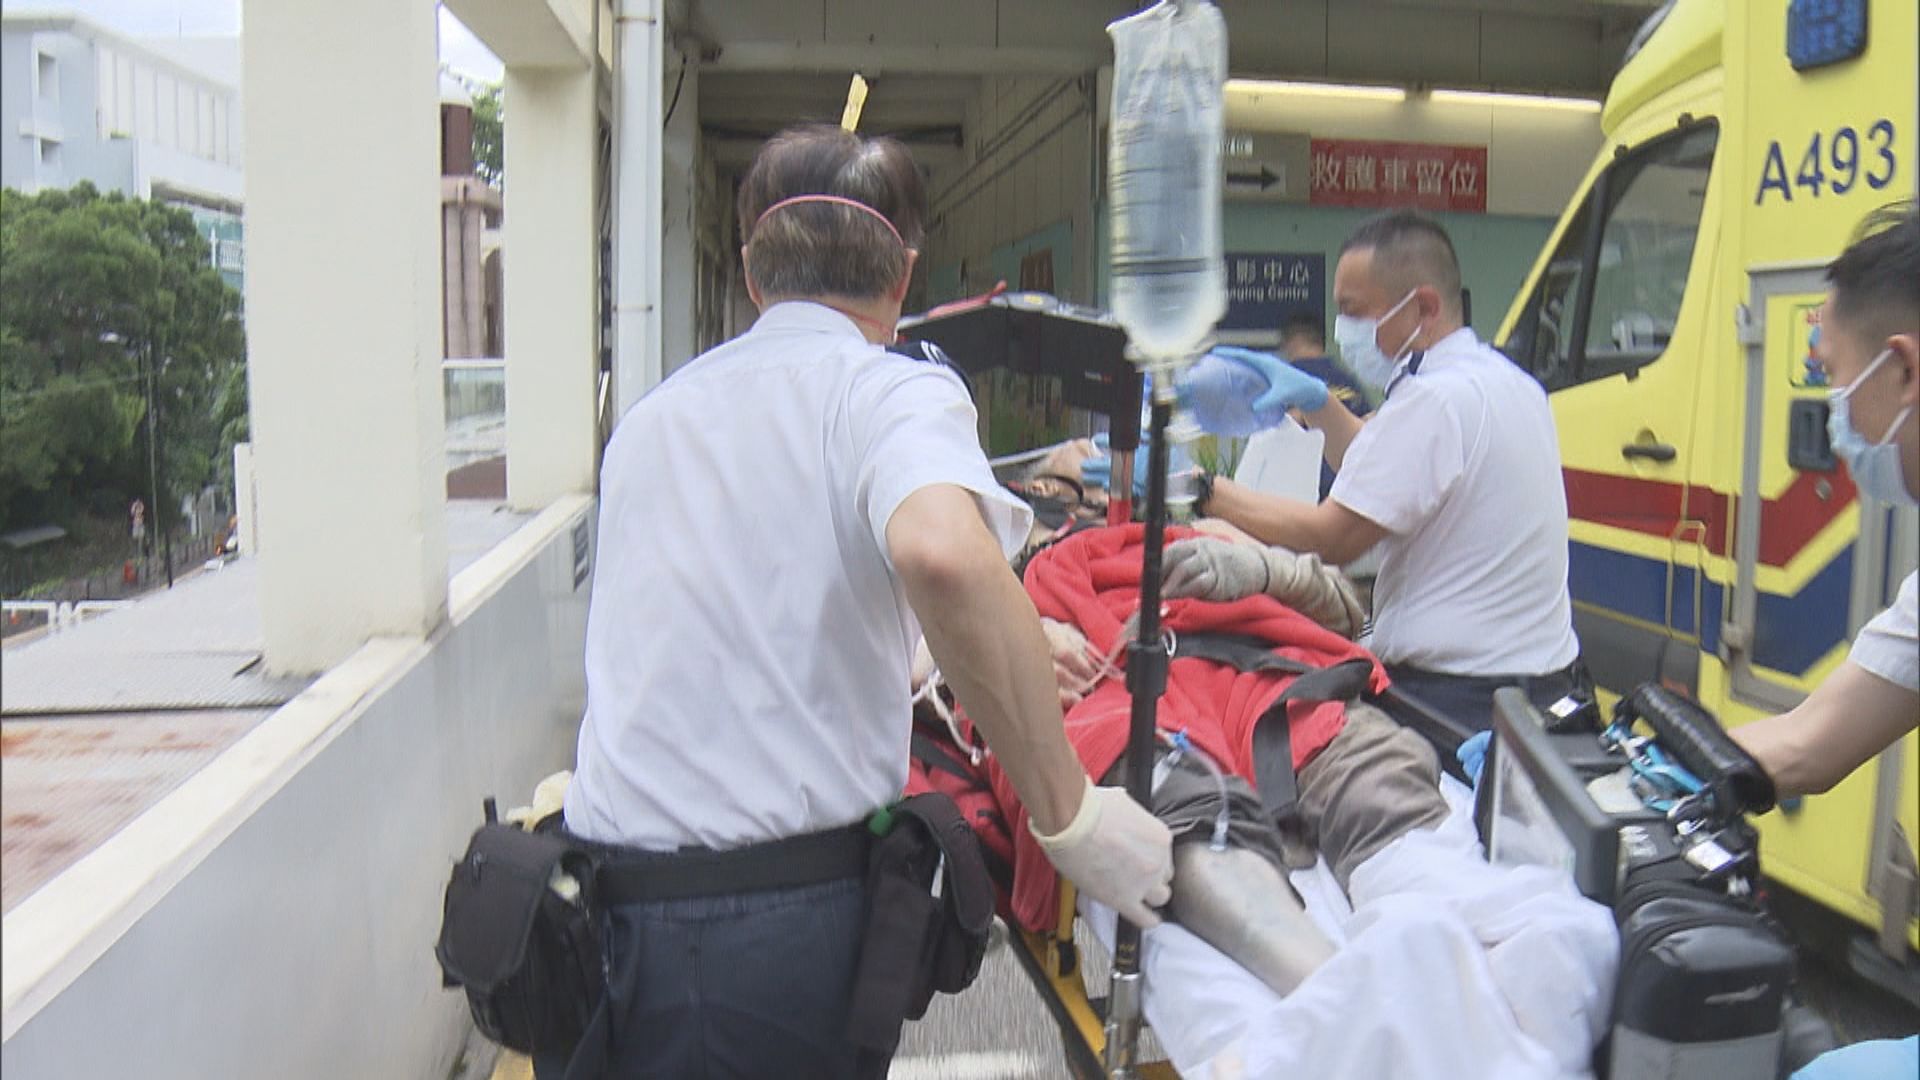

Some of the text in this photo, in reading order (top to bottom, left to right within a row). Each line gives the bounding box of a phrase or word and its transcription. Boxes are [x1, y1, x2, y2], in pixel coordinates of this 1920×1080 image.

[1312, 152, 1478, 196] 救護車留位
[1755, 119, 1896, 205] A493
[1223, 259, 1309, 285] 影中心
[1267, 286, 1309, 301] Centre
